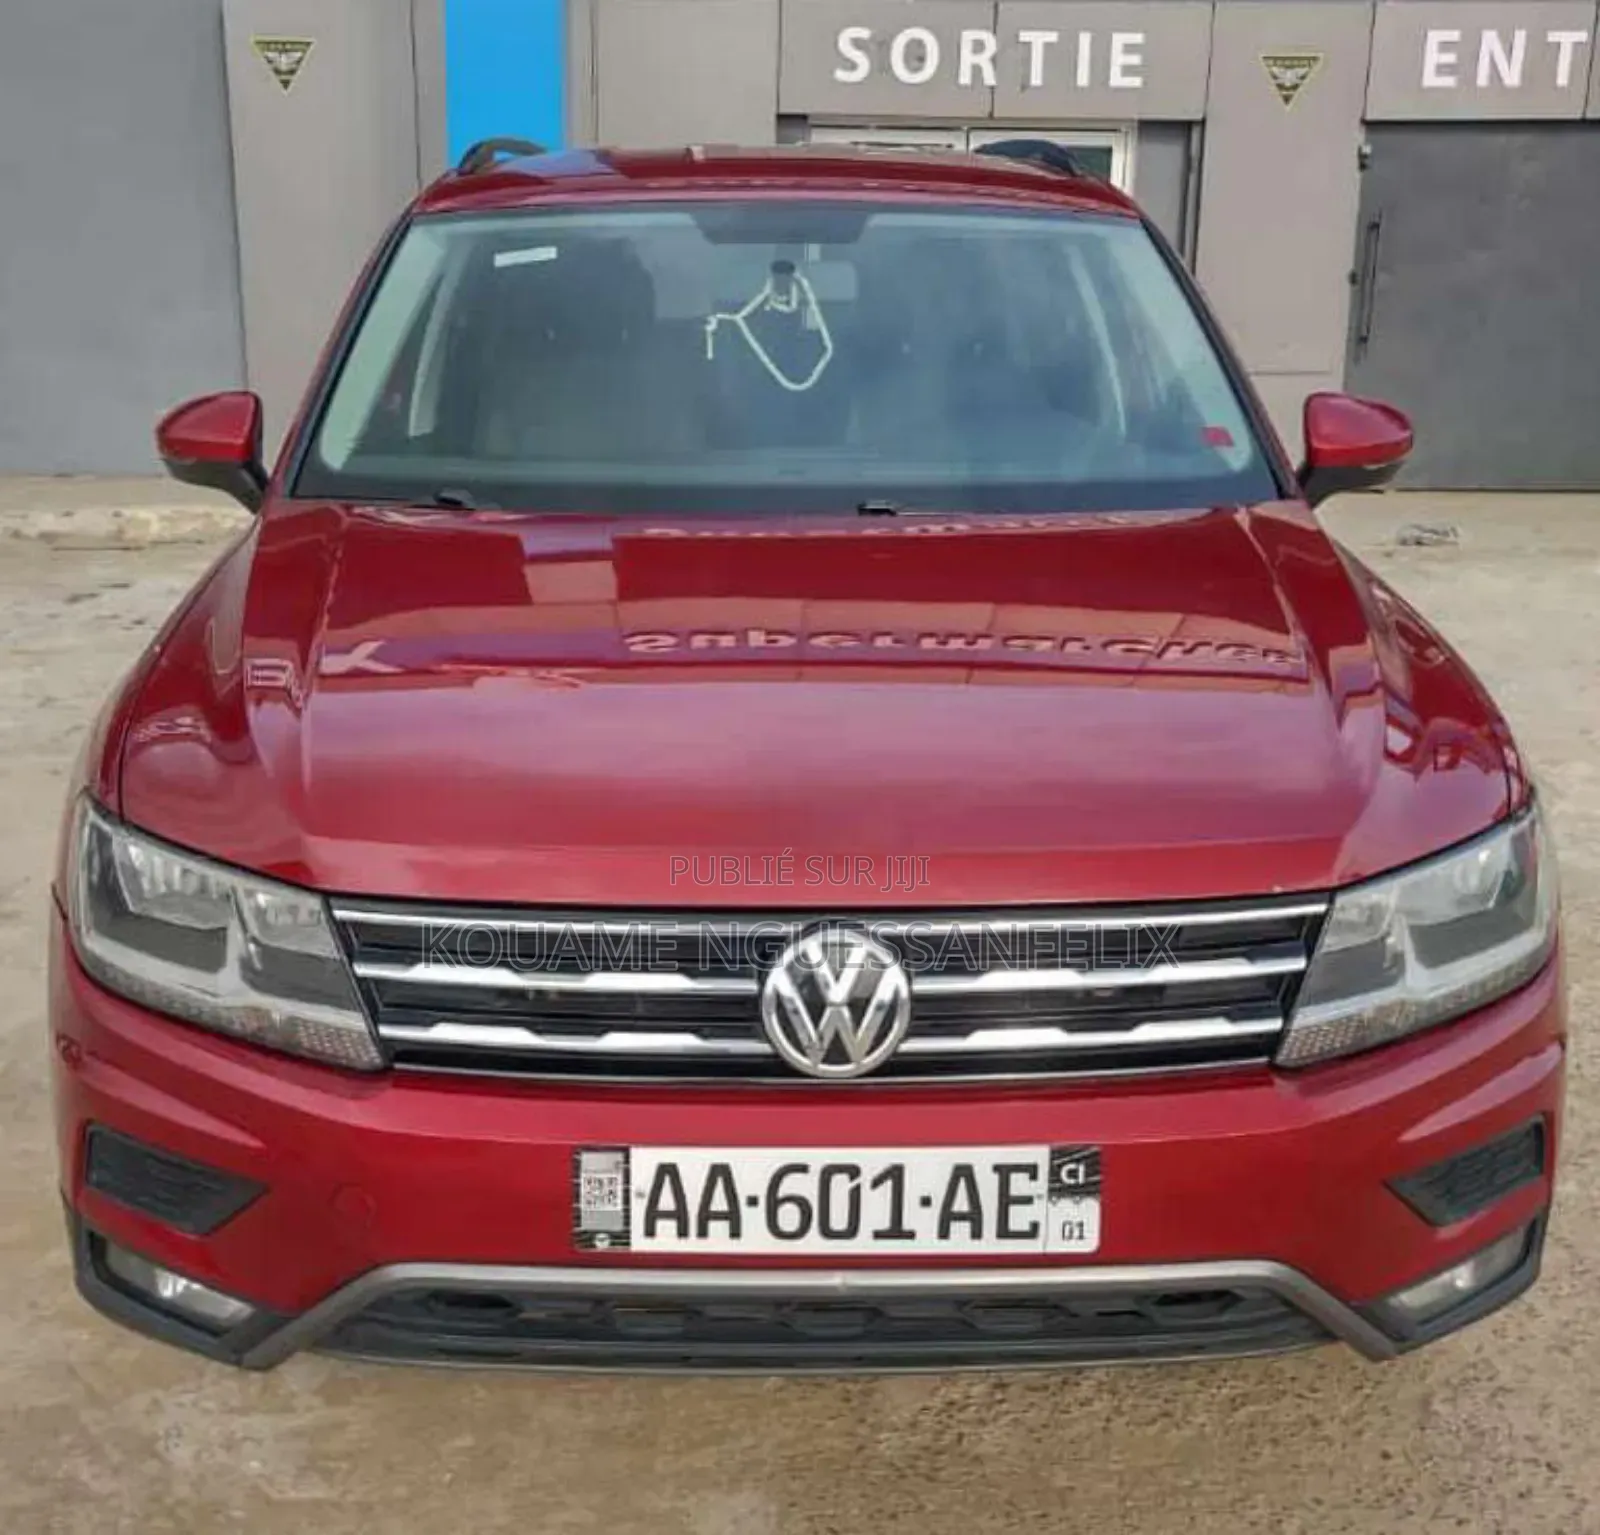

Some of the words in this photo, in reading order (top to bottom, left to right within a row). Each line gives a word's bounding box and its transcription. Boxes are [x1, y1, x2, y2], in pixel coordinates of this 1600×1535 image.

[834, 26, 1145, 87] SORTIE
[1421, 29, 1589, 88] ENT
[1060, 1163, 1085, 1185] CI
[1061, 1219, 1085, 1241] 01
